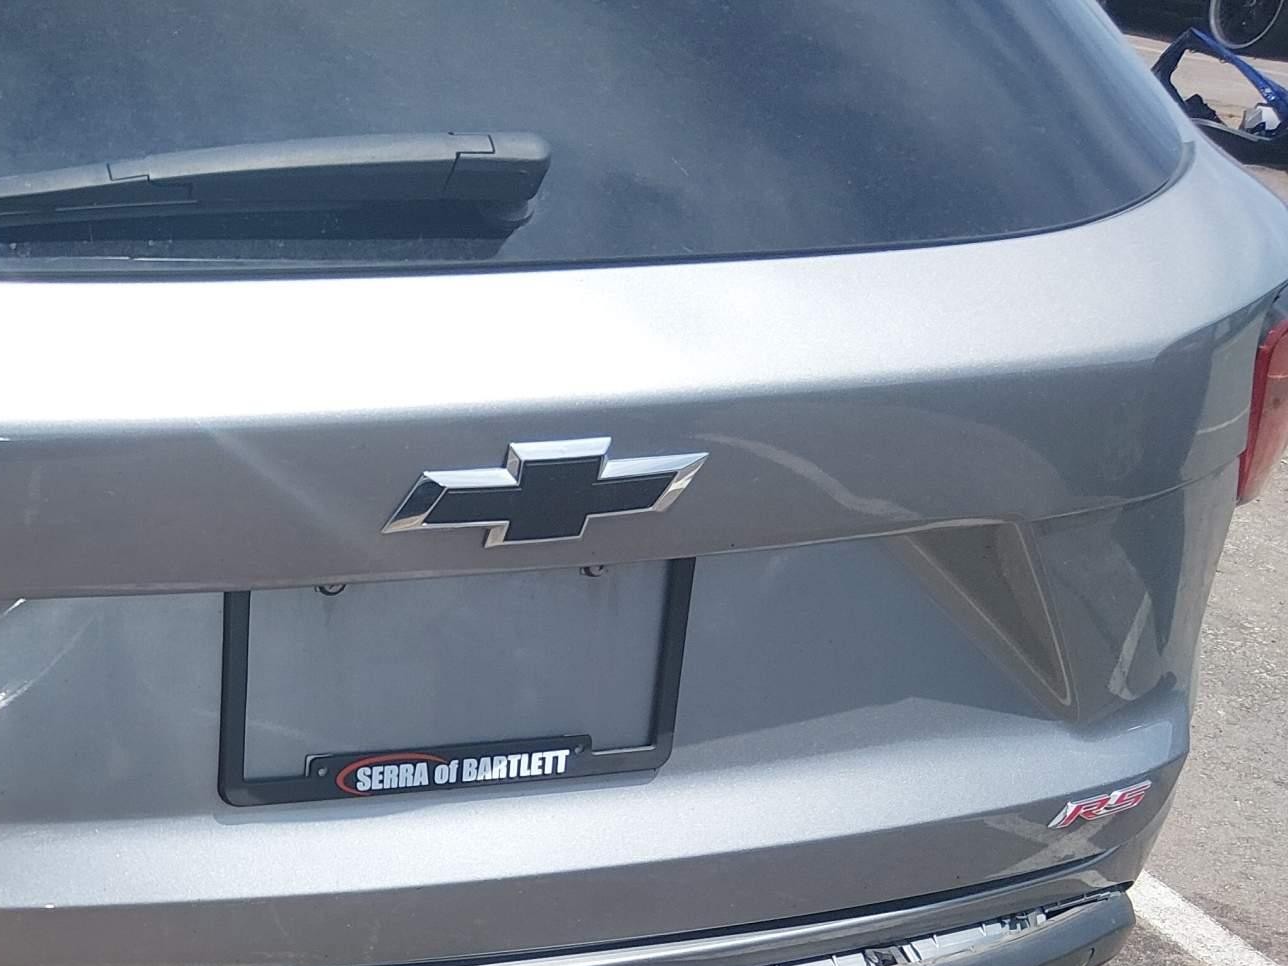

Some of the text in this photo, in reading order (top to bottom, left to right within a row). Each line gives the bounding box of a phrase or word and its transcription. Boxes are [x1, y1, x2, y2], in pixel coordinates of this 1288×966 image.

[356, 749, 570, 791] SERRA of BARTLETT
[1048, 780, 1151, 828] RS
